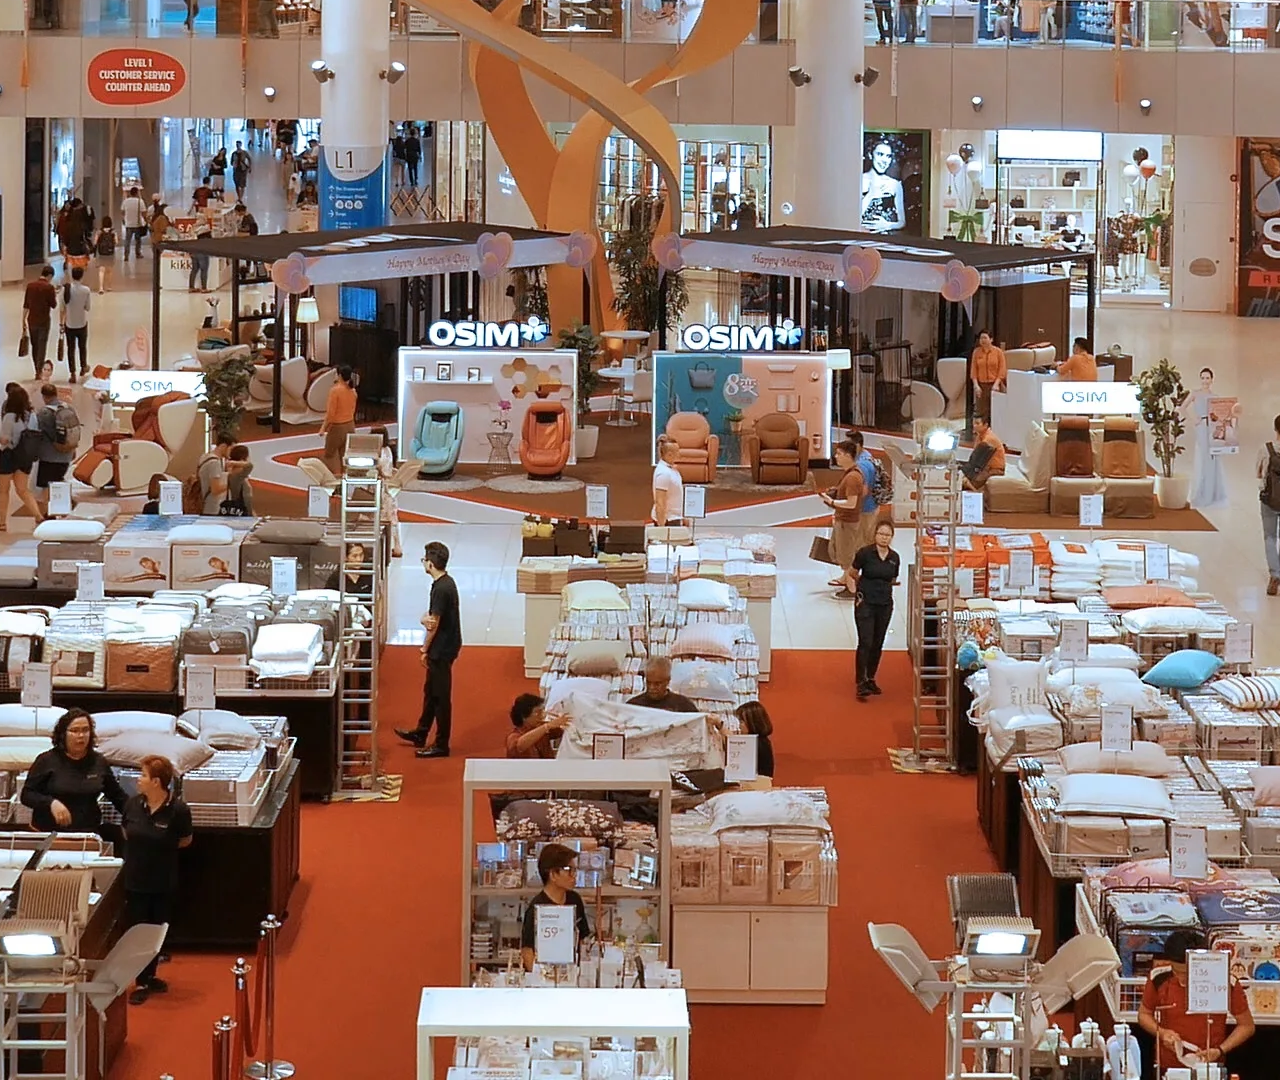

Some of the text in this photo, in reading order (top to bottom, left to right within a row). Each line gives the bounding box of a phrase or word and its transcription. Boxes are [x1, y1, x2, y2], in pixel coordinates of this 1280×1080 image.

[124, 58, 153, 67] LEVEL 1
[99, 70, 176, 80] CUSTOMER SERVICE
[105, 82, 171, 92] COUNTER AHEAD
[335, 150, 353, 169] L1
[387, 255, 415, 269] Happy
[752, 252, 835, 271] Happy Mother's Day
[428, 321, 520, 348] OSIM
[682, 324, 774, 351] OSIM
[131, 380, 173, 393] OSIM
[1061, 391, 1108, 403] OSIM
